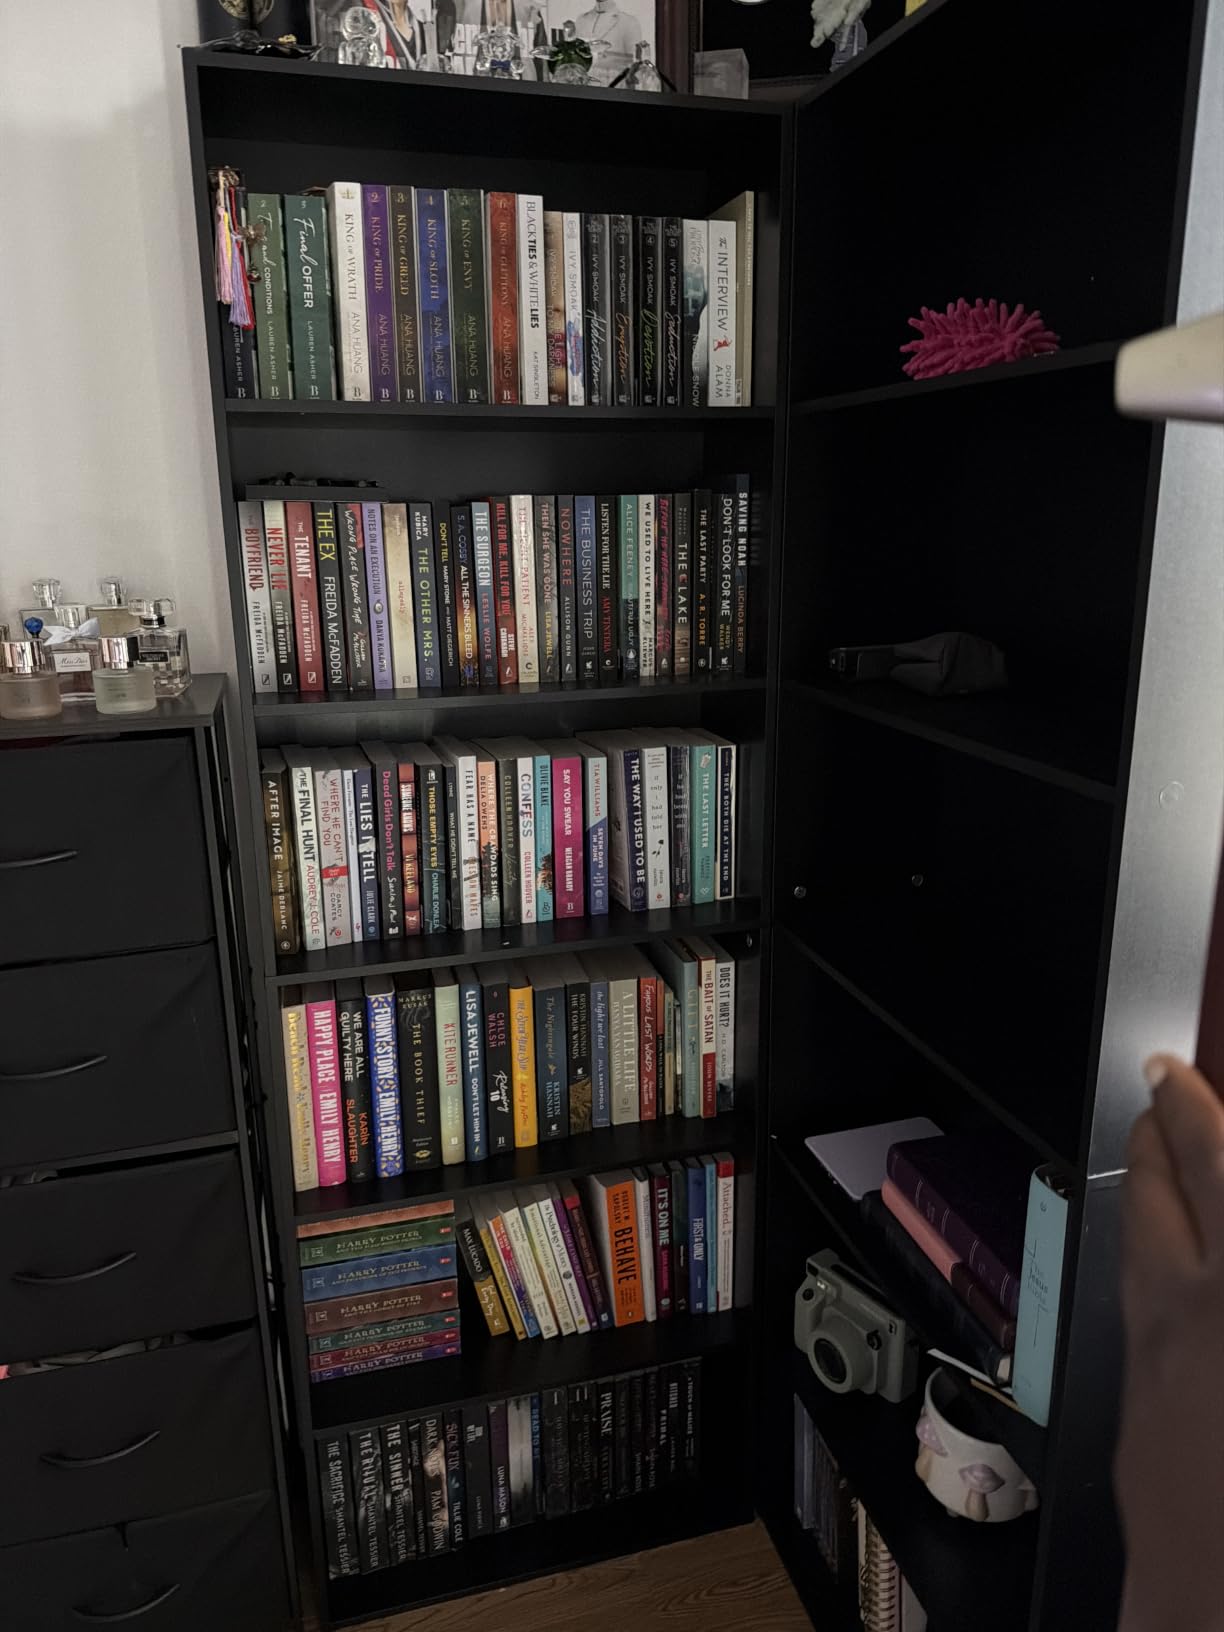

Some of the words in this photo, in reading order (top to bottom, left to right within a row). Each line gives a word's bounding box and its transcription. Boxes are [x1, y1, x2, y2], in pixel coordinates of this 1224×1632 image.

[345, 214, 354, 242] KING
[371, 216, 380, 245] KING
[397, 214, 406, 243] KING
[526, 201, 536, 239] BLACK
[262, 245, 276, 264] and
[293, 218, 318, 265] Final
[528, 239, 537, 259] TIES
[264, 267, 273, 314] CONDITIONS
[302, 266, 313, 308] OFFER
[347, 257, 356, 300] WRATH
[374, 260, 382, 292] PRIDE
[399, 257, 408, 295] GREED
[529, 269, 538, 308] WHITE
[717, 252, 728, 331] INTERVIEW
[351, 312, 360, 333] ANA
[530, 308, 539, 328] LIES
[353, 337, 362, 373] HUANG
[585, 309, 606, 388] Addiction
[640, 309, 657, 388] Devotion
[664, 312, 679, 389] Seduction
[317, 510, 333, 538] THE
[475, 512, 487, 530] THE
[581, 509, 591, 535] THE
[645, 503, 650, 517] WE
[723, 499, 732, 535] DON'T
[738, 492, 747, 533] SAVING
[344, 510, 356, 542] WRONG
[245, 528, 264, 591] BOYFRIEND
[267, 528, 285, 565] NEVER
[294, 536, 311, 578] TENANT
[320, 543, 335, 561] EX
[348, 546, 358, 572] PLACE
[418, 548, 428, 573] THE
[477, 536, 490, 586] SURGEON
[561, 508, 571, 585] NOWHERE
[645, 550, 650, 562] TO
[678, 543, 687, 570] THE
[722, 538, 732, 570] LOOK
[738, 538, 746, 566] NOAH
[272, 574, 287, 590] LIE
[460, 565, 469, 580] ALL
[581, 540, 592, 605] BUSINESS
[722, 574, 730, 597] FOR
[324, 577, 338, 618] FREIDA
[349, 574, 359, 604] WRONG
[420, 580, 432, 623] OTHER
[461, 582, 469, 598] THE
[352, 608, 362, 625] TIME
[463, 599, 471, 632] SINNERS
[679, 587, 687, 624] LAKE
[721, 600, 730, 616] ME
[583, 610, 592, 638] TRIP
[278, 629, 287, 664] McFADDEN
[328, 623, 342, 684] McFADDEN
[423, 631, 433, 661] MRS.
[299, 773, 307, 787] THE
[383, 771, 392, 796] Dead
[631, 759, 639, 781] THE
[268, 780, 278, 818] AFTER
[298, 790, 312, 826] FINAL
[330, 778, 340, 812] WHERE
[384, 799, 393, 821] Girls
[520, 774, 532, 837] CONFESS
[633, 784, 641, 808] WAY
[321, 801, 329, 822] FIND
[332, 817, 340, 829] HE
[272, 823, 283, 860] IMAGE
[302, 830, 315, 861] HUNT
[323, 828, 331, 846] YOU
[334, 834, 343, 862] CAN'T
[634, 818, 642, 848] USED
[386, 852, 395, 871] Talk
[636, 852, 643, 866] TO
[637, 870, 645, 883] BE
[704, 983, 713, 1003] BAIT
[720, 968, 731, 988] DOES
[466, 991, 478, 1019] LISA
[623, 992, 632, 1000] A
[314, 1010, 332, 1046] HAPPY
[353, 1012, 361, 1029] WE
[375, 1008, 392, 1041] FUNNY
[488, 1013, 497, 1047] WALSH
[497, 1012, 505, 1046] CHLOE
[705, 1014, 713, 1043] SATAN
[721, 1003, 729, 1027] HURT?
[340, 1012, 351, 1050] GUILTY
[355, 1032, 363, 1054] ARE
[413, 1024, 421, 1045] THE
[444, 1024, 455, 1045] KITE
[623, 1005, 635, 1056] LITTLE
[376, 1046, 394, 1079] STORY
[468, 1023, 479, 1072] JEWELL
[317, 1050, 335, 1083] PLACE
[343, 1053, 353, 1081] HERE
[356, 1057, 364, 1077] ALL
[415, 1052, 423, 1083] BOOK
[445, 1047, 457, 1086] RUNNER
[624, 1061, 636, 1092] LIFE
[320, 1092, 338, 1124] EMILY
[416, 1090, 425, 1125] THIEF
[346, 1099, 358, 1163] SLAUGHTER
[358, 1112, 369, 1145] KARIN
[323, 1129, 340, 1162] HENRY
[658, 1188, 668, 1209] IT'S
[659, 1212, 669, 1227] ON
[463, 1228, 472, 1243] MAX
[468, 1244, 482, 1272] LUCADO
[659, 1230, 669, 1246] ME
[615, 1227, 636, 1284] BEHAVE
[327, 1441, 339, 1458] THE
[387, 1424, 400, 1448] THE
[329, 1460, 344, 1504] SACRIFICE
[388, 1453, 403, 1492] SINNER
